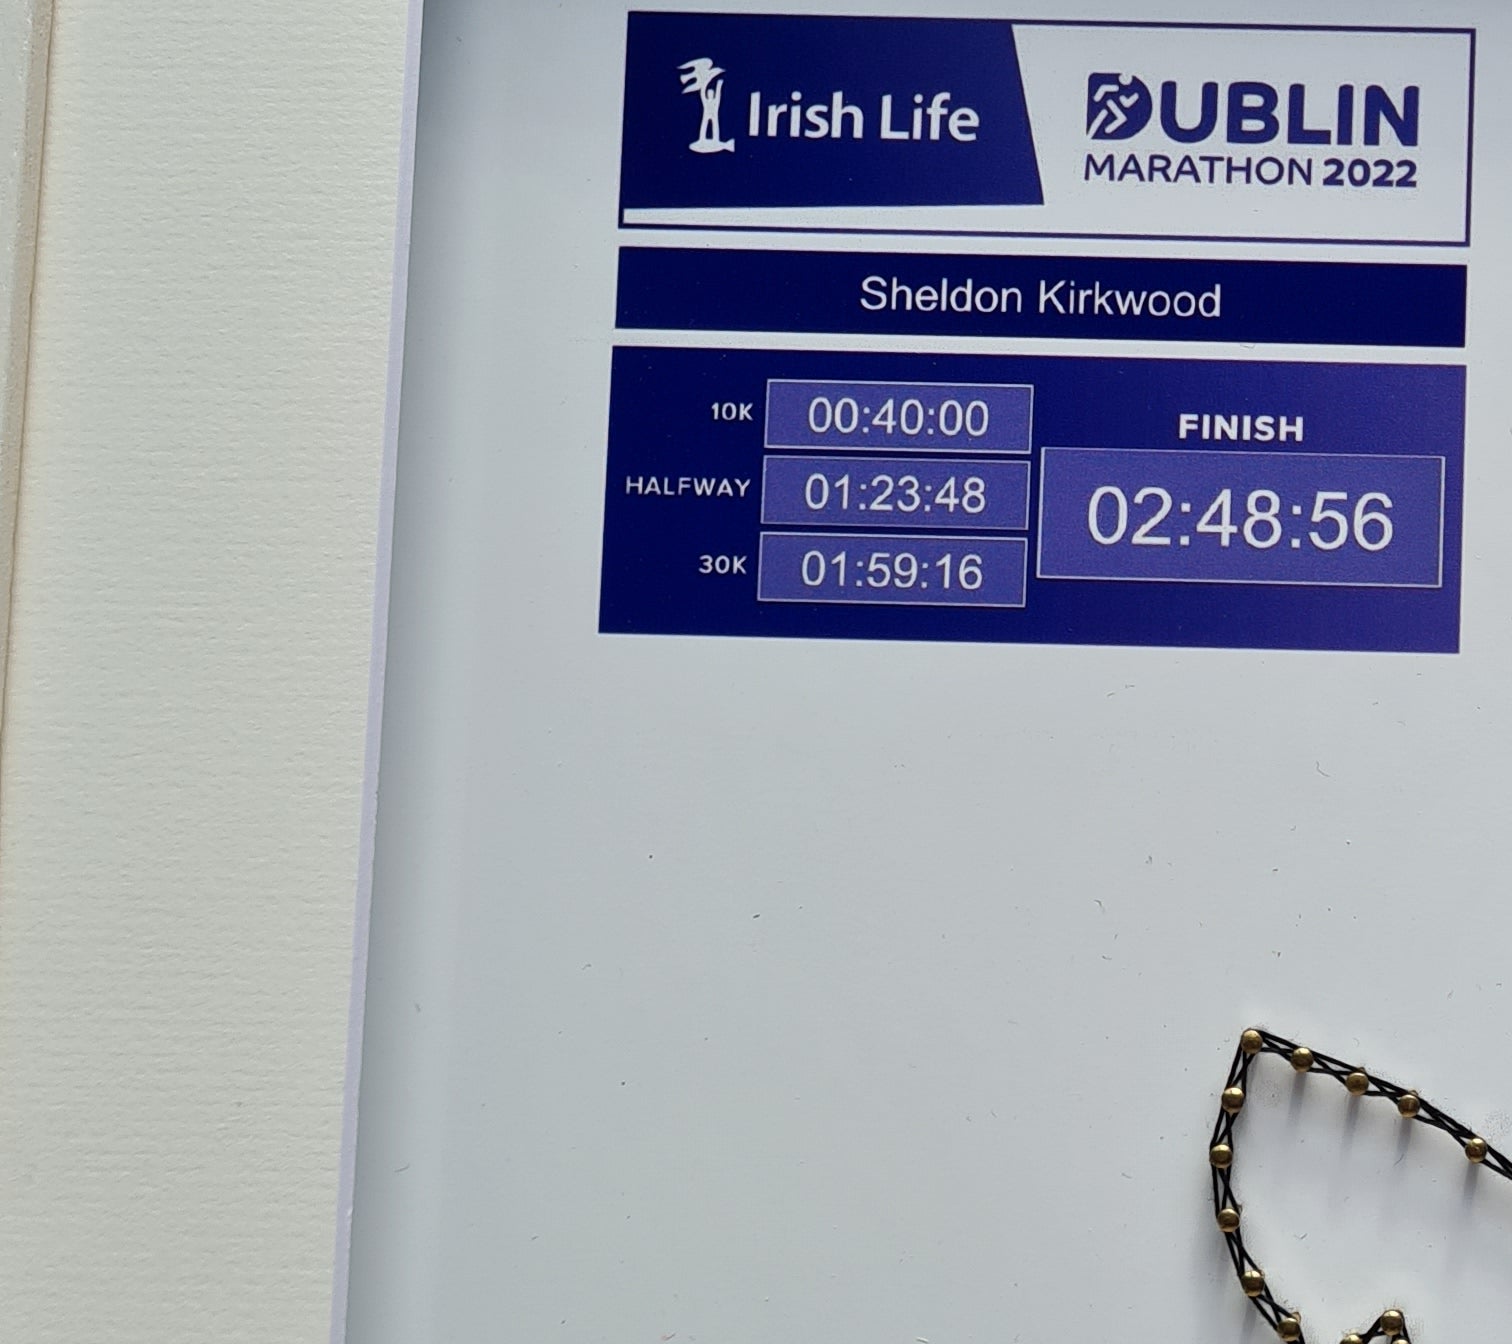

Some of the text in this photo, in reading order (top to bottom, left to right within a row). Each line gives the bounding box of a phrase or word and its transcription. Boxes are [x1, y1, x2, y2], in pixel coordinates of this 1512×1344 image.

[749, 90, 980, 142] Irish Life
[1086, 72, 1420, 147] DUBLIN
[1084, 153, 1417, 188] MARATHON 2022
[860, 275, 1221, 318] Sheldon Kirkwood
[711, 396, 989, 437] 10K 00:40:00
[1179, 413, 1304, 442] FINISH
[625, 472, 986, 514] HALFWAY 01:23:48
[1088, 485, 1393, 551] 02:48:56
[698, 550, 983, 590] 30K 01:59:16
